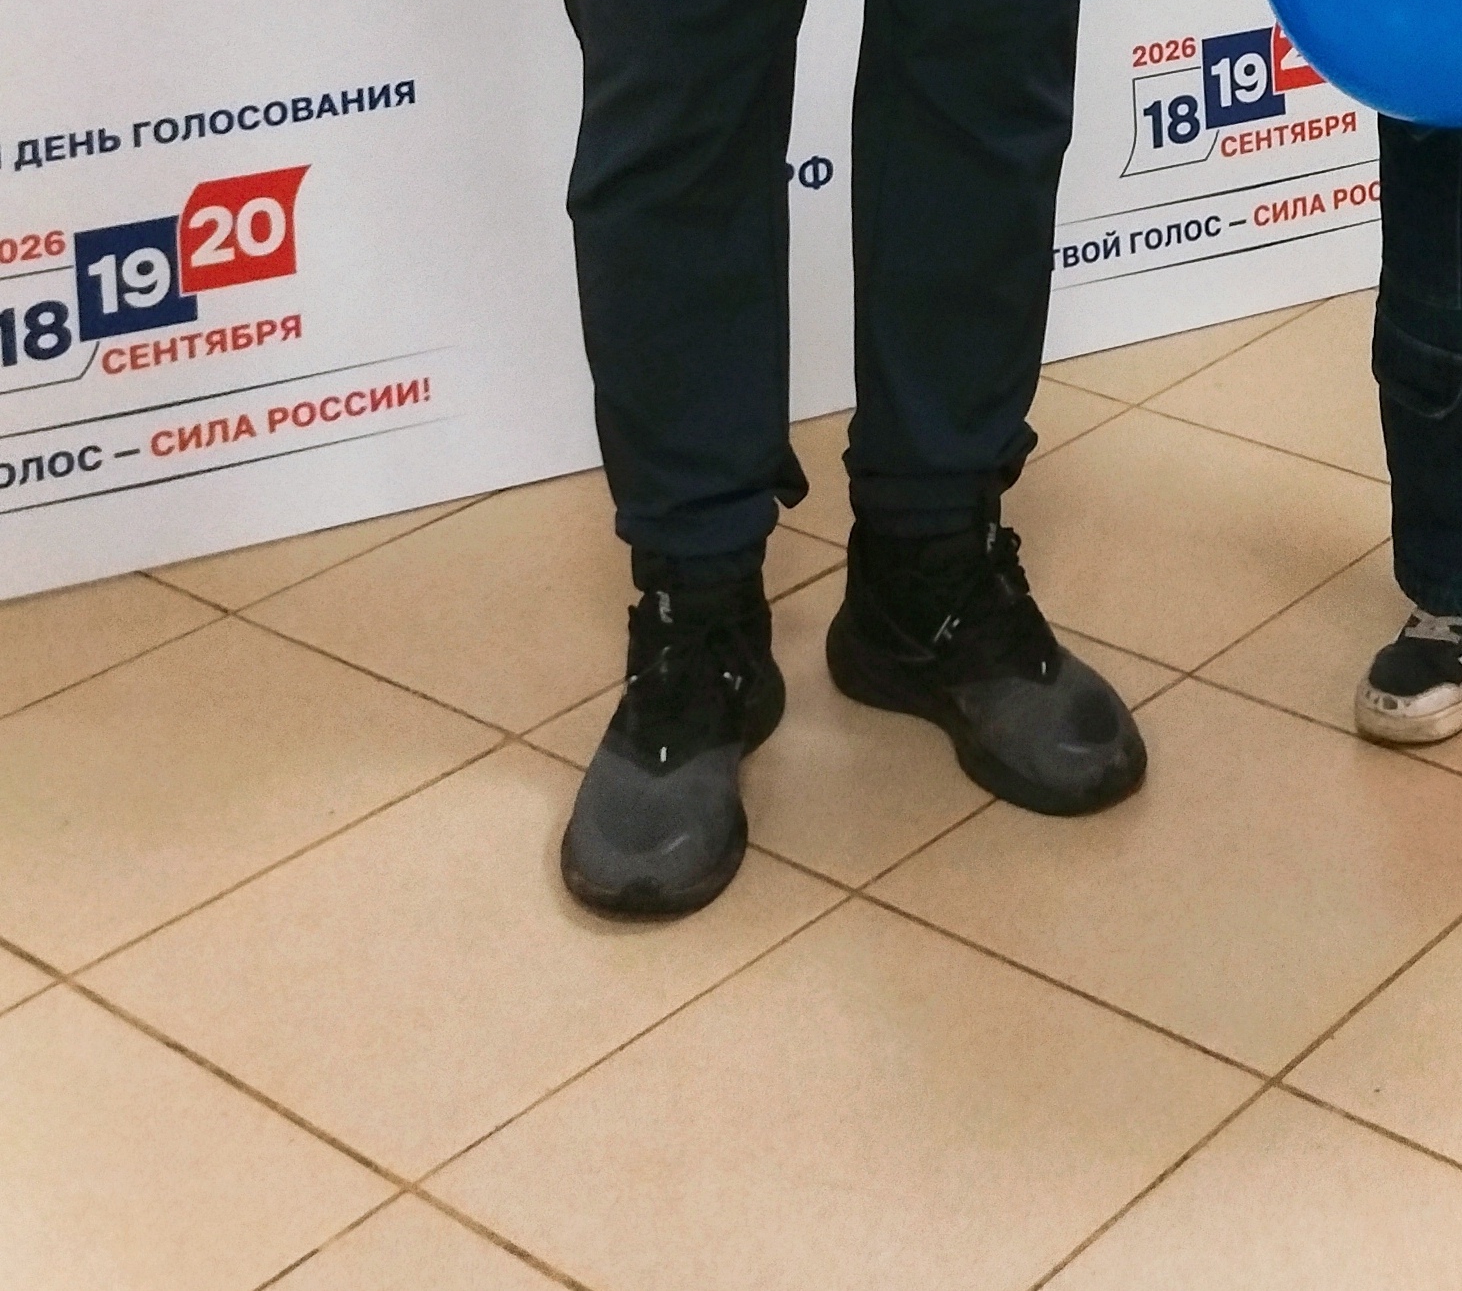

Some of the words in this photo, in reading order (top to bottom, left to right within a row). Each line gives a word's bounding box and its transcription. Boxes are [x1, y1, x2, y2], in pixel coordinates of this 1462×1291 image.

[1132, 37, 1196, 67] 2026
[14, 127, 121, 171] ДЕНЬ
[133, 79, 416, 148] ГОЛОСОВАНИЯ
[1143, 94, 1201, 149] 18
[1211, 52, 1268, 107] 19
[1220, 111, 1357, 158] СЕНТЯБРЯ
[0, 230, 66, 264] 026
[1053, 230, 1121, 268] ВОЙ
[1130, 215, 1221, 253] ГОЛОС
[1254, 193, 1326, 227] СИЛА
[1334, 181, 1380, 210] РОС
[0, 300, 72, 367] 18
[89, 247, 171, 315] 19
[189, 197, 286, 267] 20
[102, 314, 302, 375] СЕНТЯБРЯ
[0, 445, 102, 490] ОЛОС
[151, 414, 257, 458] СИЛА
[268, 377, 431, 433] РОССИИ!
